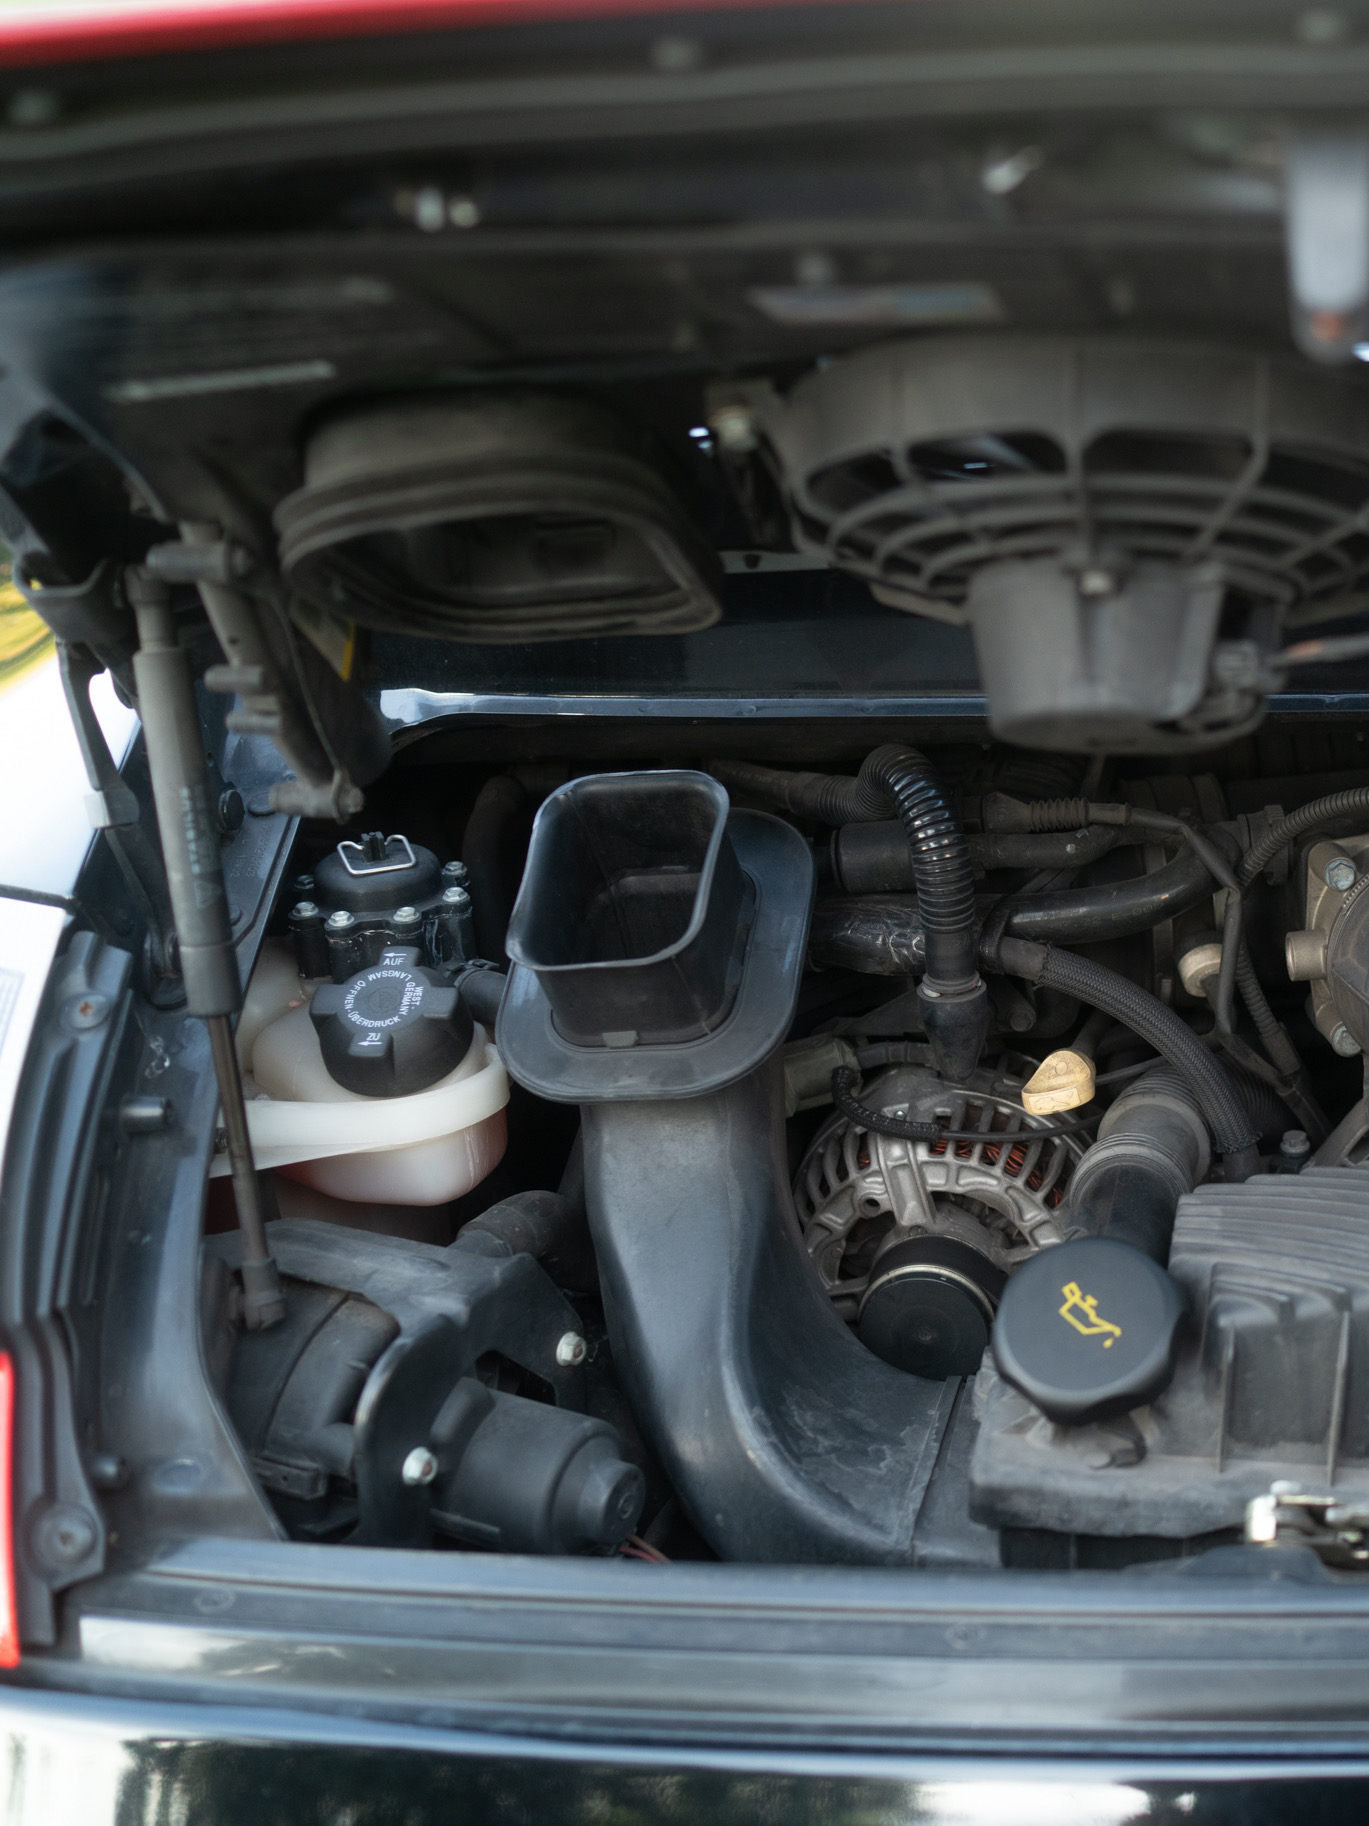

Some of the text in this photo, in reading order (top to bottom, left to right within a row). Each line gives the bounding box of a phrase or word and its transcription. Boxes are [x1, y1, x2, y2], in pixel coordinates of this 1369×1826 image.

[383, 957, 405, 966] AUF
[344, 970, 412, 1028] ÜBERDRUCK LANGSAM ÖFFNEN
[399, 982, 416, 1016] GERMANY
[366, 1032, 381, 1041] ZU
